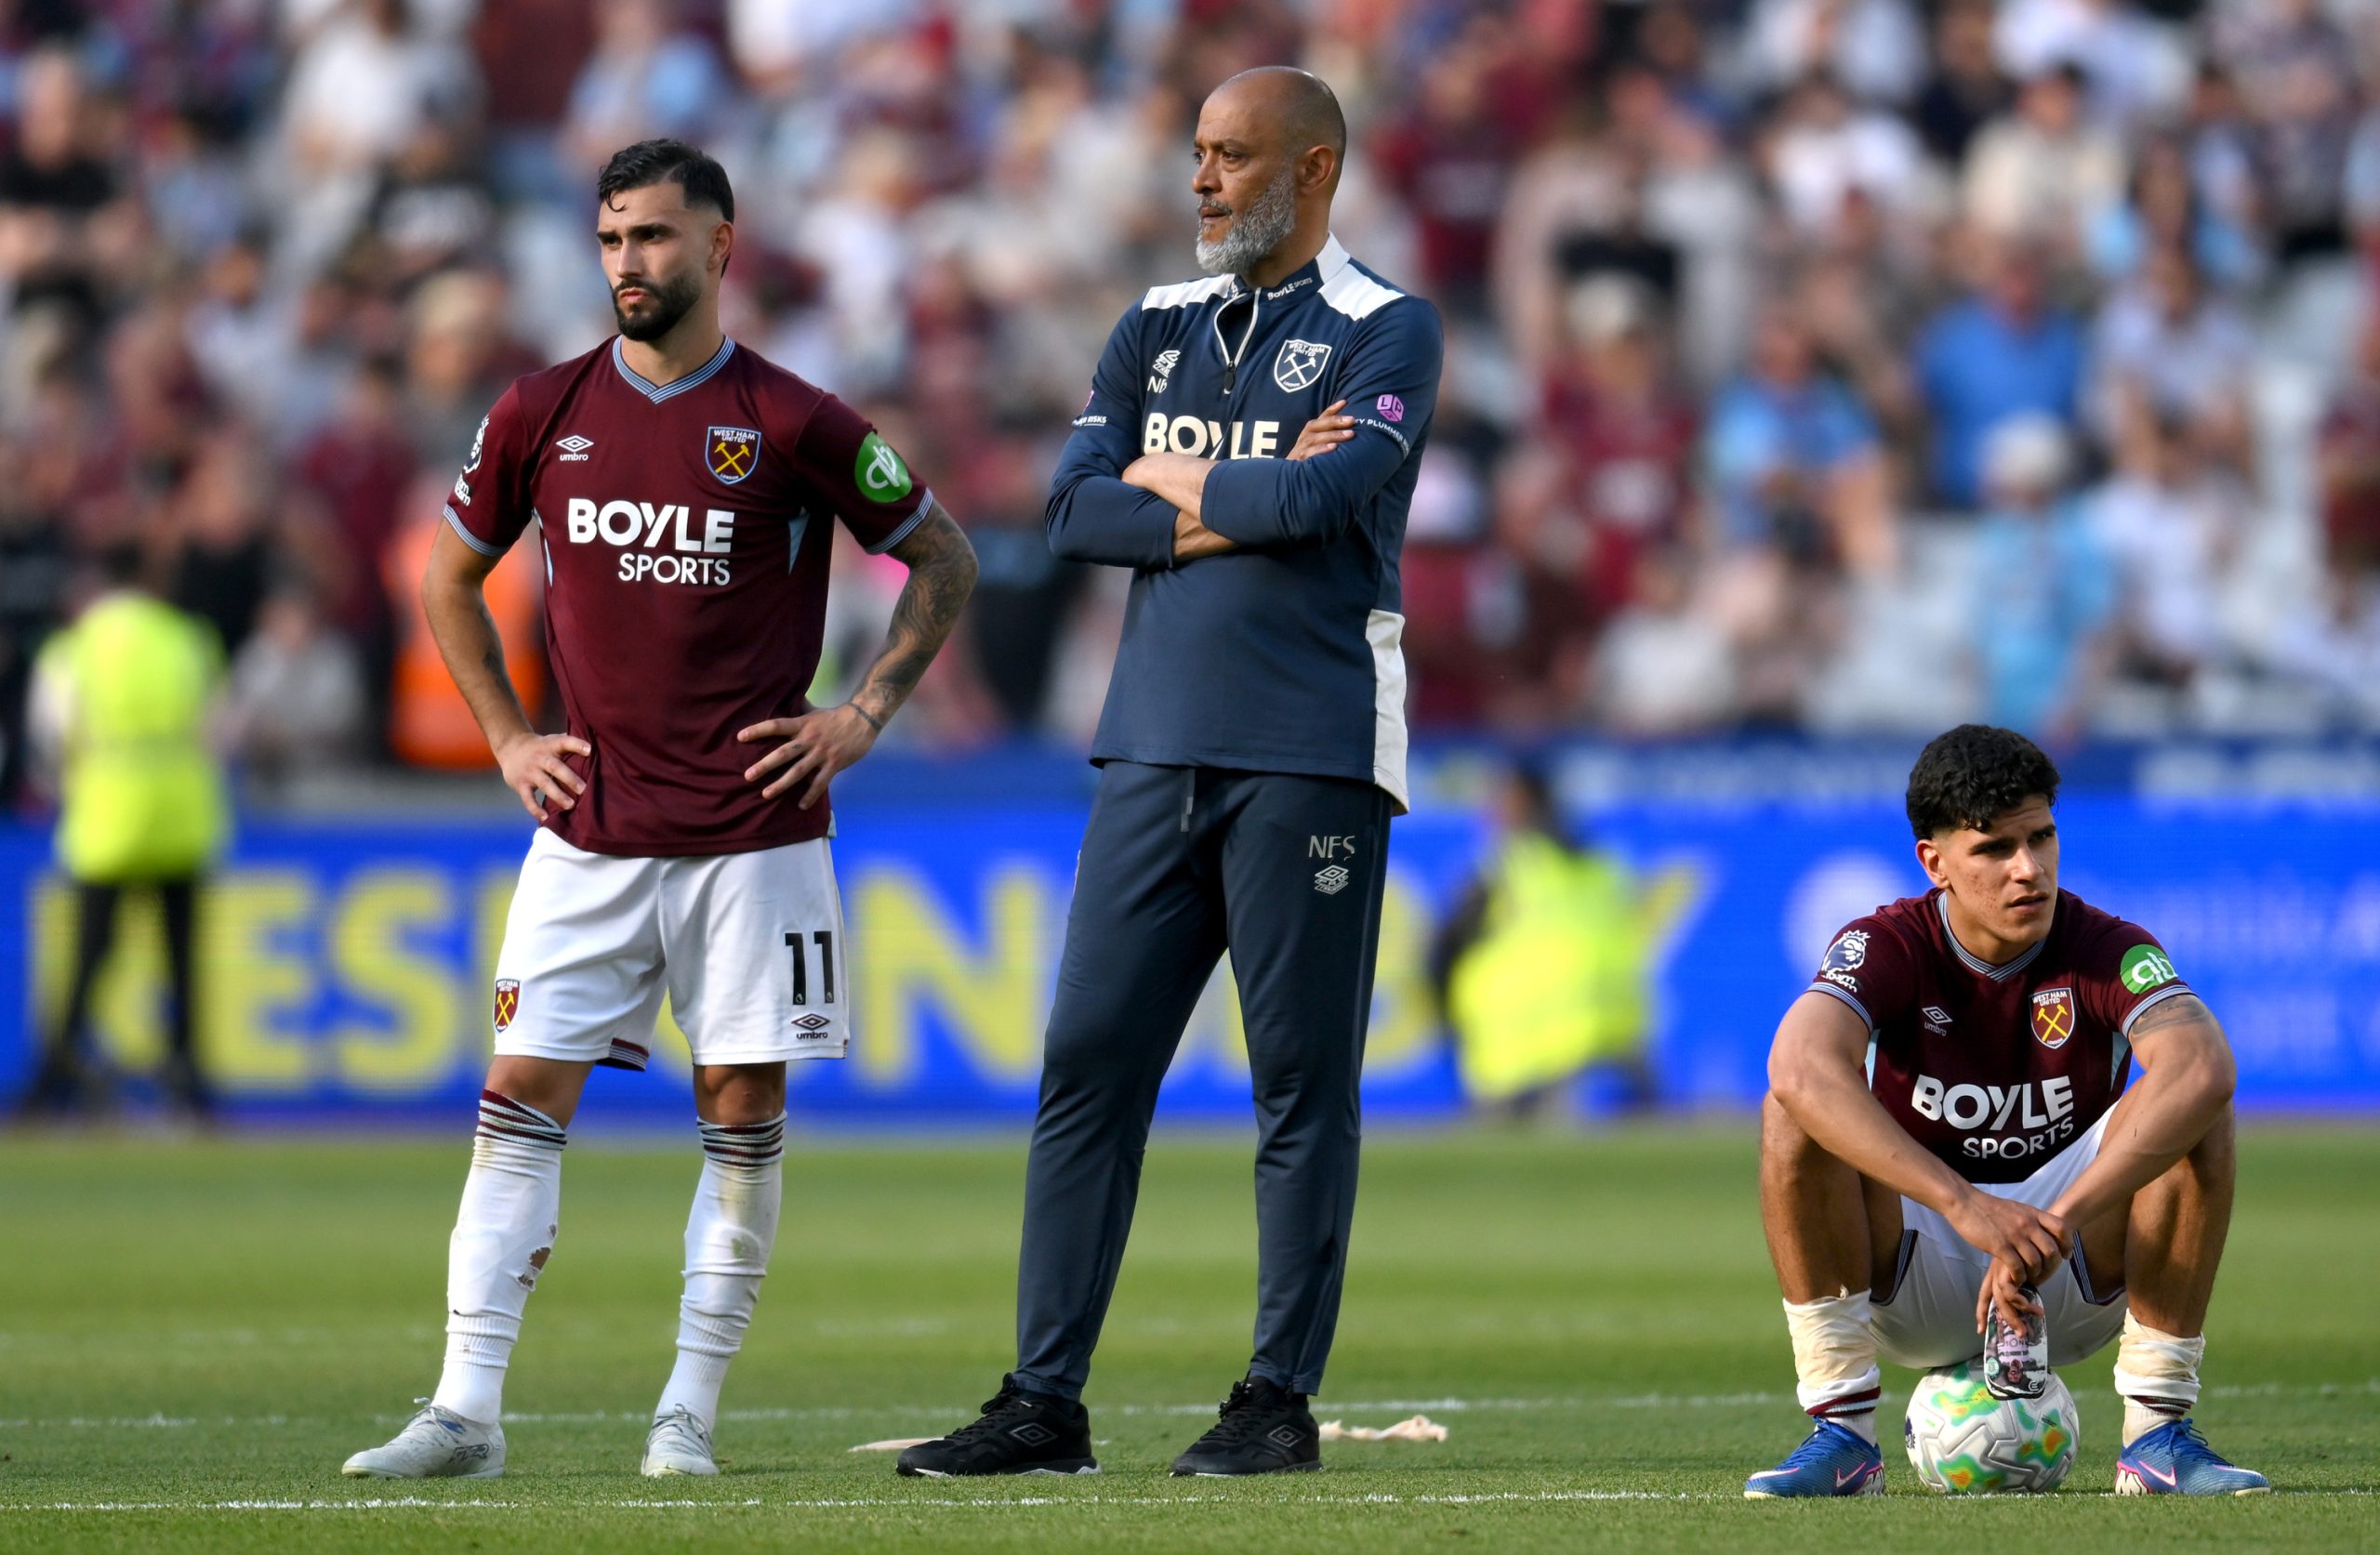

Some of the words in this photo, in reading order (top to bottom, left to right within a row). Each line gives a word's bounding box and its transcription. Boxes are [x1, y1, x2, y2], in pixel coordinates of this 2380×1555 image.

[736, 430, 756, 441] HAM
[559, 452, 589, 462] umbro
[567, 497, 735, 553] BOYLE
[618, 552, 732, 586] SPORTS
[785, 930, 835, 1006] 11
[2032, 994, 2050, 1004] WEST
[2051, 990, 2068, 999] HAM
[796, 1031, 828, 1040] umbro
[1924, 1021, 1947, 1037] umbro
[1911, 1074, 2074, 1131] BOYLE
[1963, 1115, 2074, 1160] SPORTS
